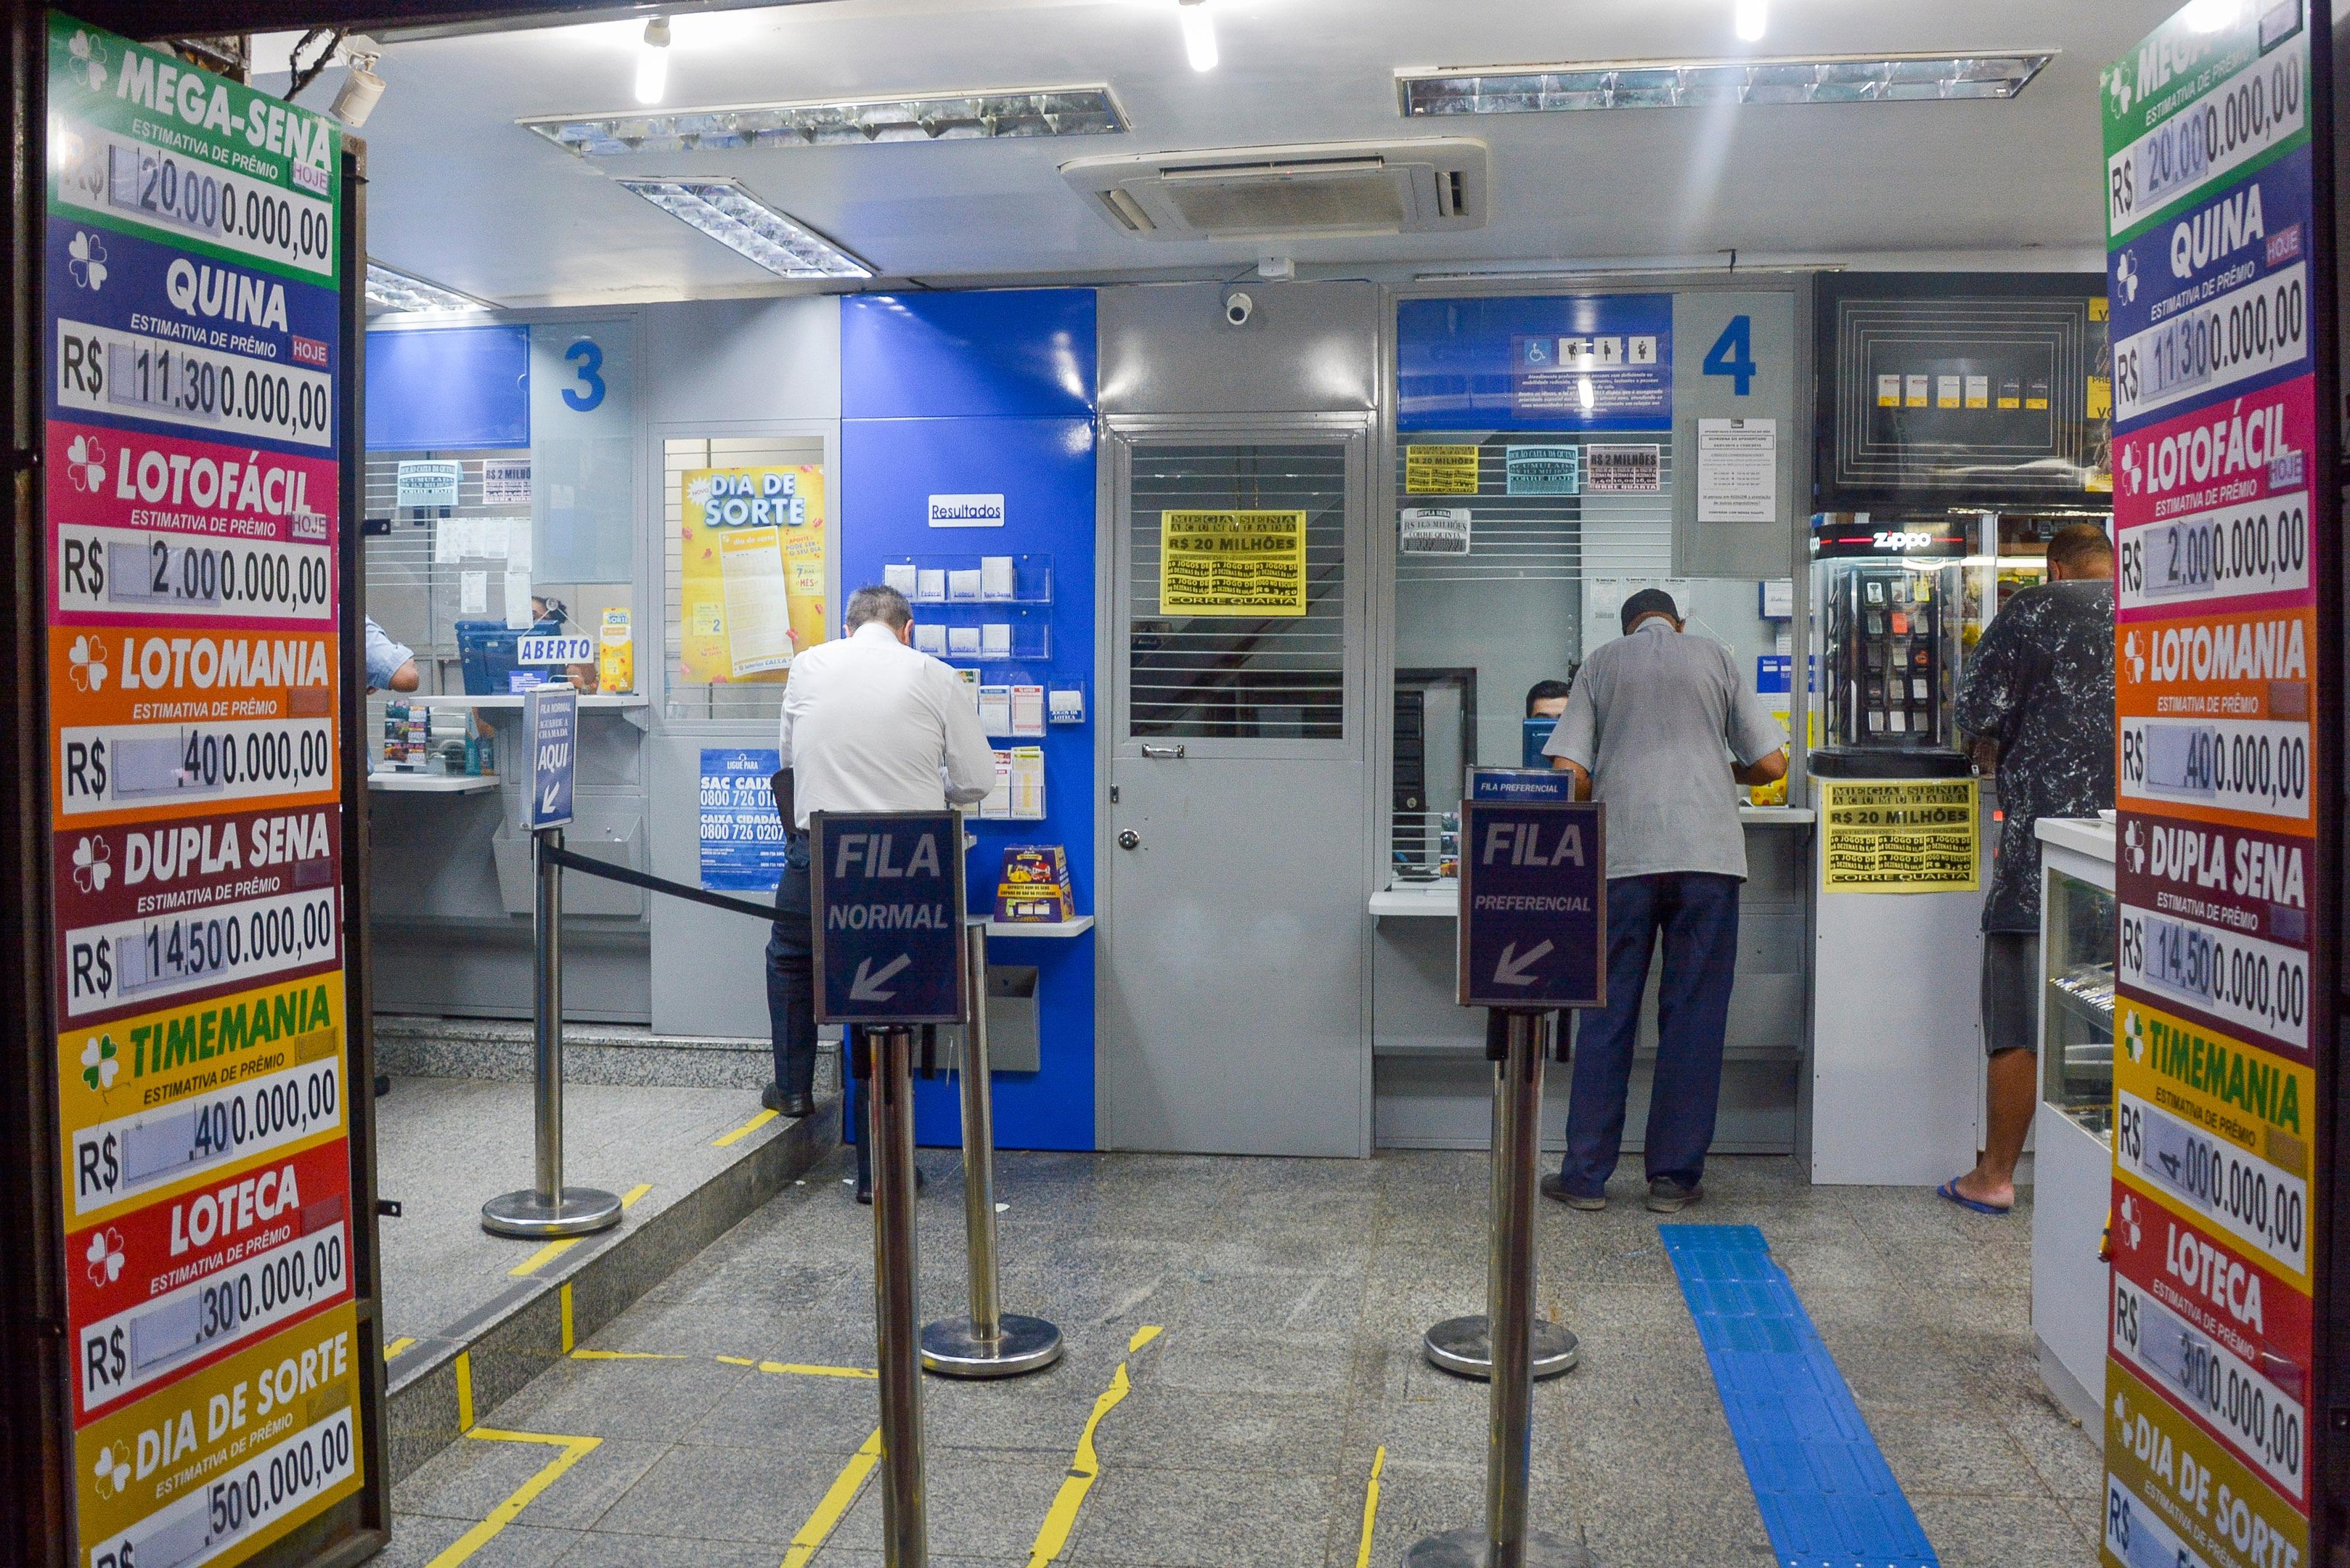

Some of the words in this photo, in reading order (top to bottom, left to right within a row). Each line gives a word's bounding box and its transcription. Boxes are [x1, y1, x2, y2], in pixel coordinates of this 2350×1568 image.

[117, 50, 332, 172] MEGA-SENA
[132, 118, 208, 158] ESTIMATIVA
[212, 146, 229, 163] DE
[232, 152, 278, 180] PRÊMIO
[293, 160, 327, 191] HOJE
[139, 155, 327, 262] 20.000.000,00
[2113, 157, 2133, 219] R$
[2171, 182, 2264, 279] QUINA
[167, 258, 288, 332] QUINA
[131, 314, 207, 343] ESTIMATIVA
[211, 332, 227, 347] DE
[231, 335, 277, 357] PRÊMIO
[293, 341, 327, 362] HOJE
[1702, 314, 1756, 396] 4
[64, 335, 103, 400] R$
[561, 341, 605, 412] 3
[2118, 346, 2138, 406] R$
[498, 470, 502, 479] 2
[505, 468, 531, 480] MILHÕ
[1605, 454, 1611, 464] 2
[1614, 452, 1656, 465] MILHÕES
[2147, 398, 2289, 494] LOTOFÁCIL
[117, 450, 311, 515] LOTOFÁCIL
[705, 498, 804, 527] SORTE
[711, 474, 755, 498] DIA
[764, 474, 795, 497] DE
[931, 504, 1000, 519] Resultados
[131, 510, 206, 530] ESTIMATIVA
[210, 519, 227, 532] DE
[230, 518, 276, 536] PRÊMIO
[293, 516, 327, 534] HOJE
[1169, 537, 1189, 550] R$
[1194, 538, 1213, 550] 20
[1220, 536, 1295, 550] MILHÕES
[1172, 515, 1233, 523] MEGA
[1240, 515, 1297, 523] SENA
[65, 537, 104, 602] R$
[152, 540, 327, 612] 2.000.000,00
[797, 568, 802, 578] 7
[2122, 536, 2142, 597] R$
[521, 639, 590, 660] ABERTO
[713, 619, 720, 632] 2
[2151, 619, 2306, 682] LOTOMANIA
[121, 637, 328, 689] LOTOMANIA
[134, 702, 208, 719] ESTIMATIVA
[212, 702, 228, 716] DE
[232, 697, 277, 715] PRÊMIO
[67, 737, 106, 800] R$
[538, 743, 568, 773] AQUI
[701, 777, 730, 790] SAC
[735, 777, 773, 790] CAIX
[727, 761, 743, 769] LIGUE
[744, 761, 759, 769] PARA
[2124, 727, 2143, 788] R$
[701, 790, 729, 806] 0800
[733, 791, 754, 807] 726
[1481, 783, 1498, 791] FILA
[1500, 783, 1558, 793] PREFERENCIAL
[1832, 812, 1853, 823] R$
[1858, 812, 1879, 823] 20
[1886, 808, 1968, 824] MILHÕES
[1833, 787, 1899, 796] MEGA
[1907, 785, 1968, 795] SENA
[124, 822, 241, 885] DUPLA
[250, 812, 330, 867] SENA
[701, 814, 733, 823] CAIXA
[701, 824, 729, 839] 0800
[733, 825, 754, 840] 726
[756, 825, 784, 841] 0207
[1483, 822, 1585, 867] FILA
[835, 833, 941, 878] FILA
[1899, 873, 1968, 882] QUARTA
[2151, 825, 2227, 891] DUPLA
[2233, 838, 2305, 907] SENA
[137, 888, 212, 912] ESTIMATIVA
[216, 885, 232, 899] DE
[234, 876, 280, 895] PRÊMIO
[828, 905, 948, 929] NORMAL
[1475, 894, 1591, 912] PREFERENCIAL
[73, 936, 113, 998] R$
[2123, 917, 2142, 978] R$
[130, 984, 330, 1077] TIMEMANIA
[144, 1074, 218, 1105] ESTIMATIVA
[221, 1068, 237, 1083] DE
[240, 1053, 285, 1078] PRÊMIO
[2150, 1019, 2300, 1134] TIMEMANIA
[79, 1132, 118, 1196] R$
[2121, 1103, 2141, 1167] R$
[170, 1164, 300, 1257] LOTECA
[150, 1252, 224, 1294] ESTIMATIVA
[227, 1246, 242, 1262] DE
[245, 1225, 290, 1255] PRÊMIO
[2166, 1222, 2263, 1334] LOTECA
[2117, 1287, 2137, 1352] R$
[87, 1325, 126, 1392] R$
[136, 1410, 197, 1481] DIA
[208, 1384, 247, 1443] DE
[257, 1331, 348, 1415] SORTE
[155, 1451, 229, 1499] ESTIMATIVA
[230, 1442, 246, 1458] DE
[249, 1414, 293, 1446] PRÊMIO
[2134, 1413, 2174, 1487] DIA
[2179, 1452, 2211, 1517] DE
[2109, 1487, 2130, 1556] R$
